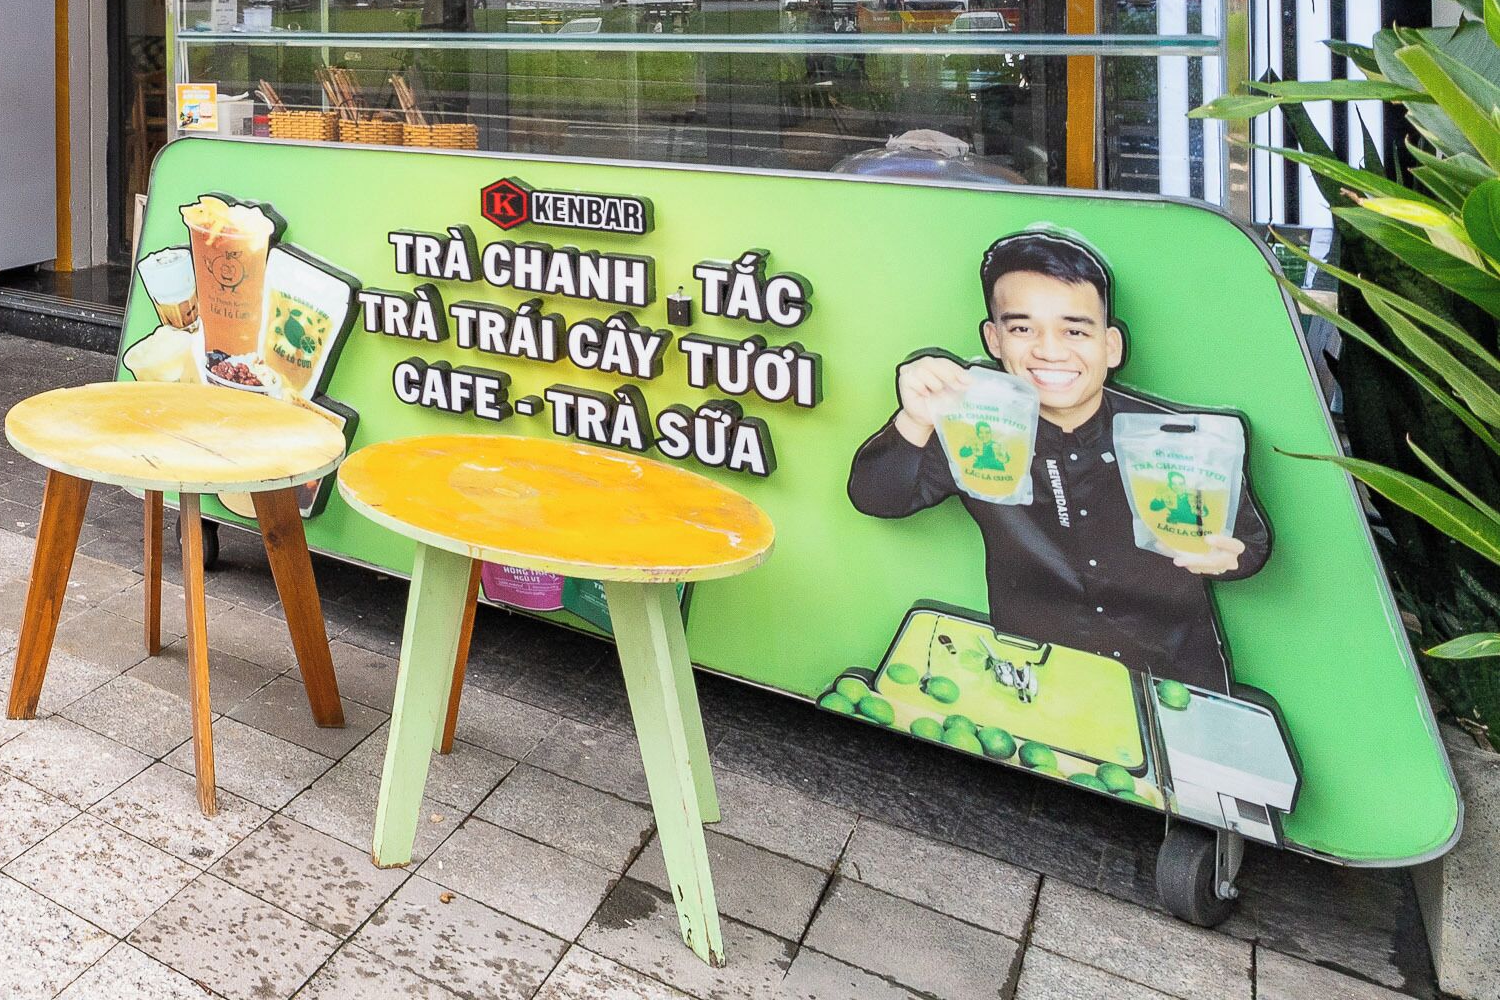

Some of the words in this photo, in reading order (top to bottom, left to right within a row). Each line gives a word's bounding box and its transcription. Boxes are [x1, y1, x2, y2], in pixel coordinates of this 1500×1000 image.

[533, 192, 644, 233] KENBAR
[389, 227, 473, 282] TRÀ
[483, 243, 648, 307] CHANH
[694, 252, 804, 328] TẮC
[358, 290, 439, 343] TRÀ
[450, 304, 556, 362] TRÁI
[568, 318, 661, 379] CÂY
[679, 340, 814, 408] TƯƠI
[393, 361, 503, 421] CAFE
[545, 390, 647, 451] TRÀ
[656, 407, 769, 477] SỮA
